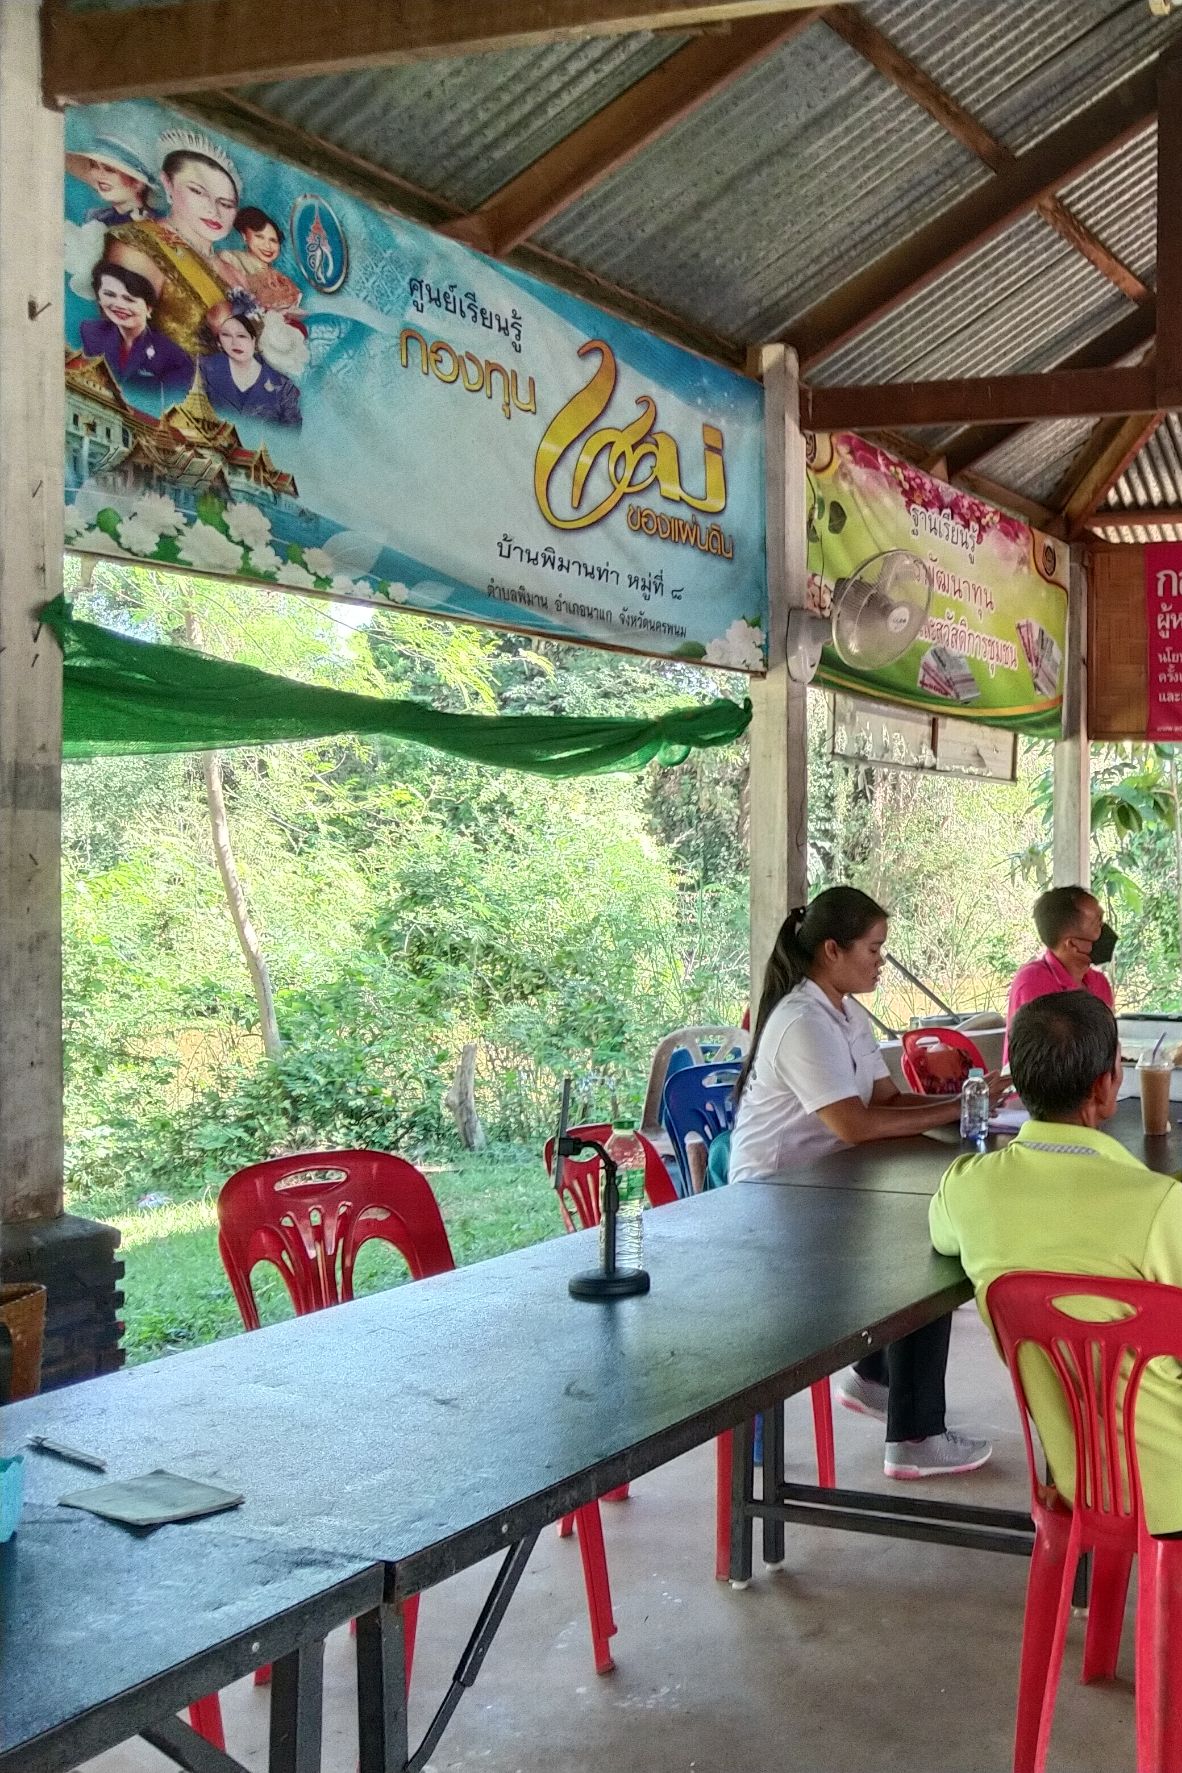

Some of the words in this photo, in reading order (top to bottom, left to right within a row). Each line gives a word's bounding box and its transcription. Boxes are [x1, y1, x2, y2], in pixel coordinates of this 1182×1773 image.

[408, 277, 522, 353] ศูนย์เรียนรู้
[400, 328, 537, 418] กองทุน
[626, 503, 734, 560] ของแผ่นดิน
[910, 505, 978, 564] ฐานเรียนรู้
[497, 533, 620, 586] บ้านพิมานท่า
[627, 569, 664, 601] หมู่ที่
[486, 577, 548, 609] ตำบลพิมาน
[554, 593, 613, 624] อำเภอนาแก
[619, 606, 687, 638] จังหวัดนครพนม
